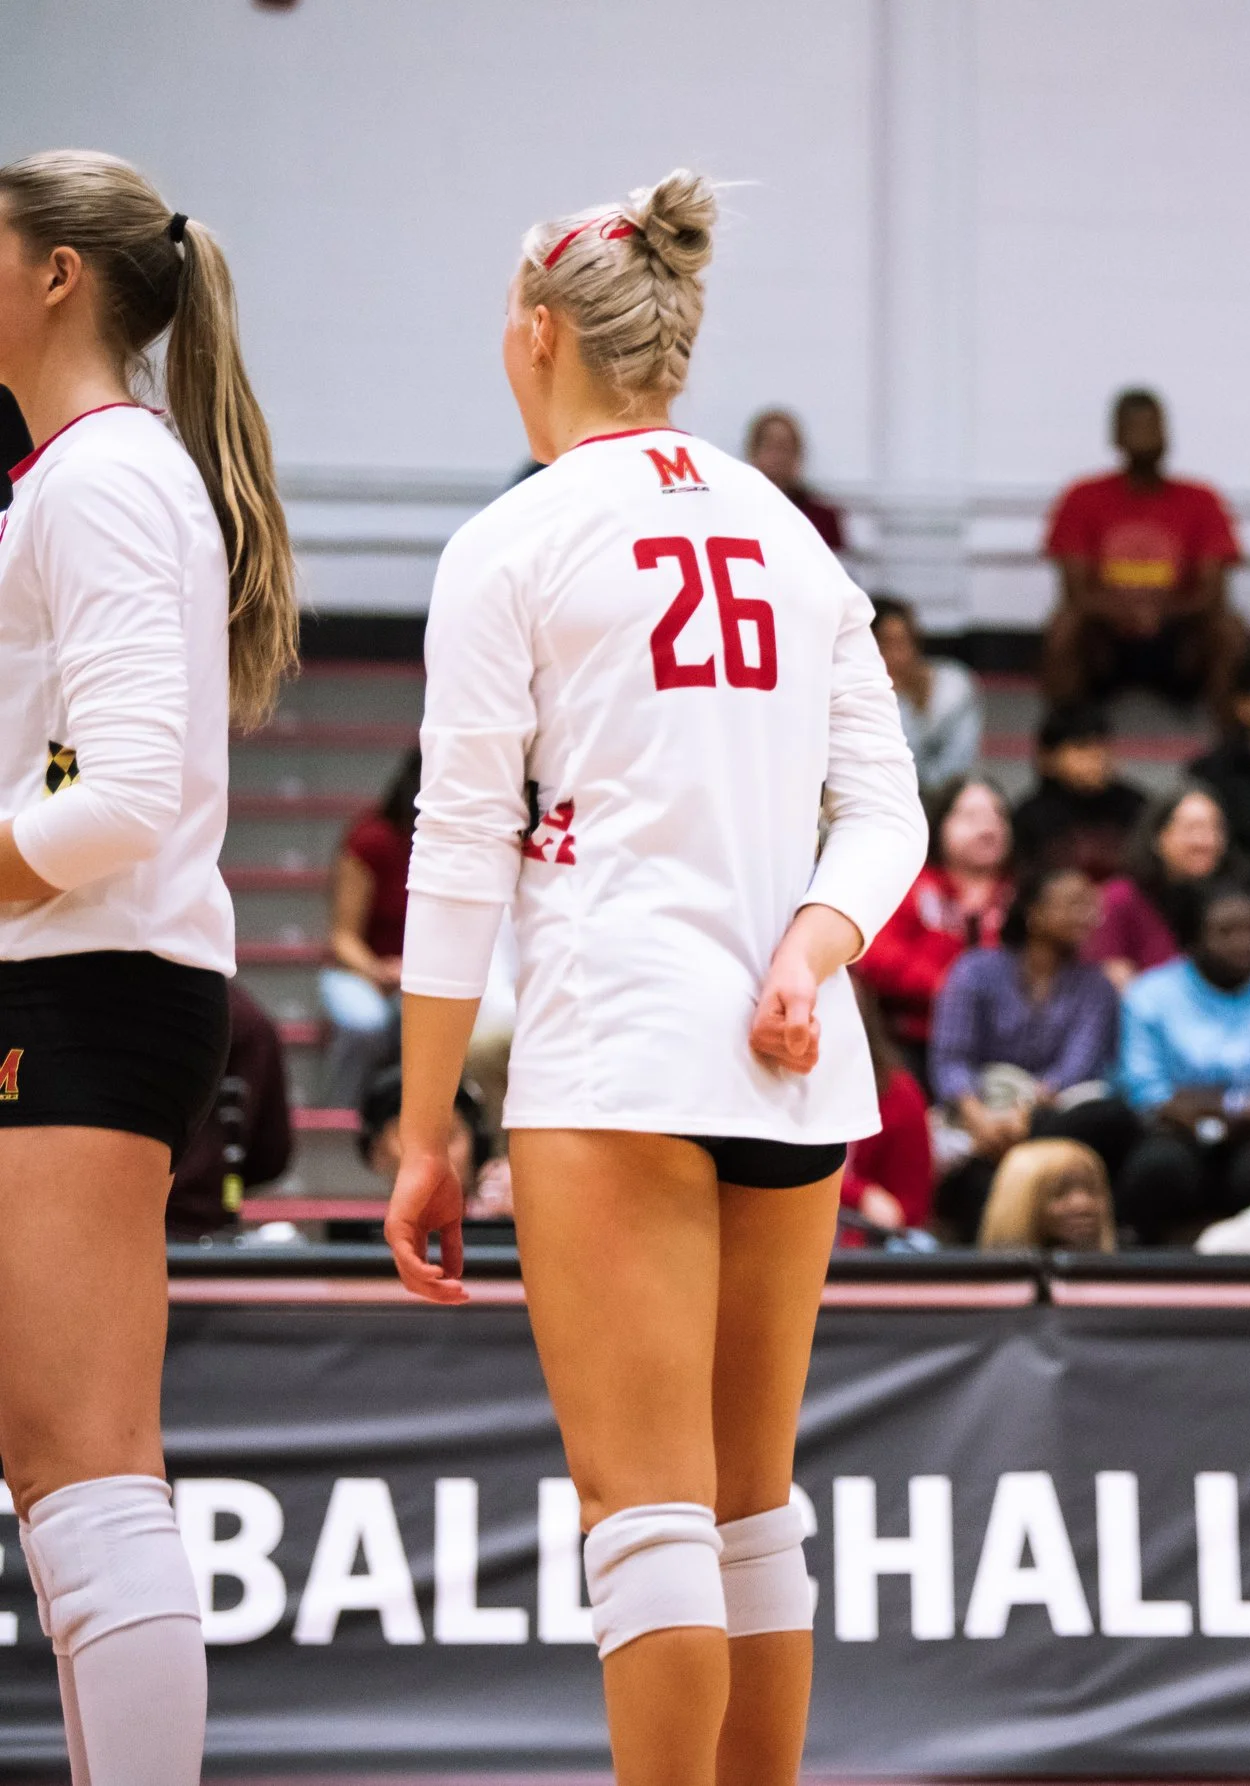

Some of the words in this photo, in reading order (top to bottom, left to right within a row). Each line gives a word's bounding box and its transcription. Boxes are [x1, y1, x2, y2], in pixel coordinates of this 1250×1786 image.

[642, 446, 707, 487] M
[632, 536, 777, 691] 26
[0, 1477, 599, 1645] BALL
